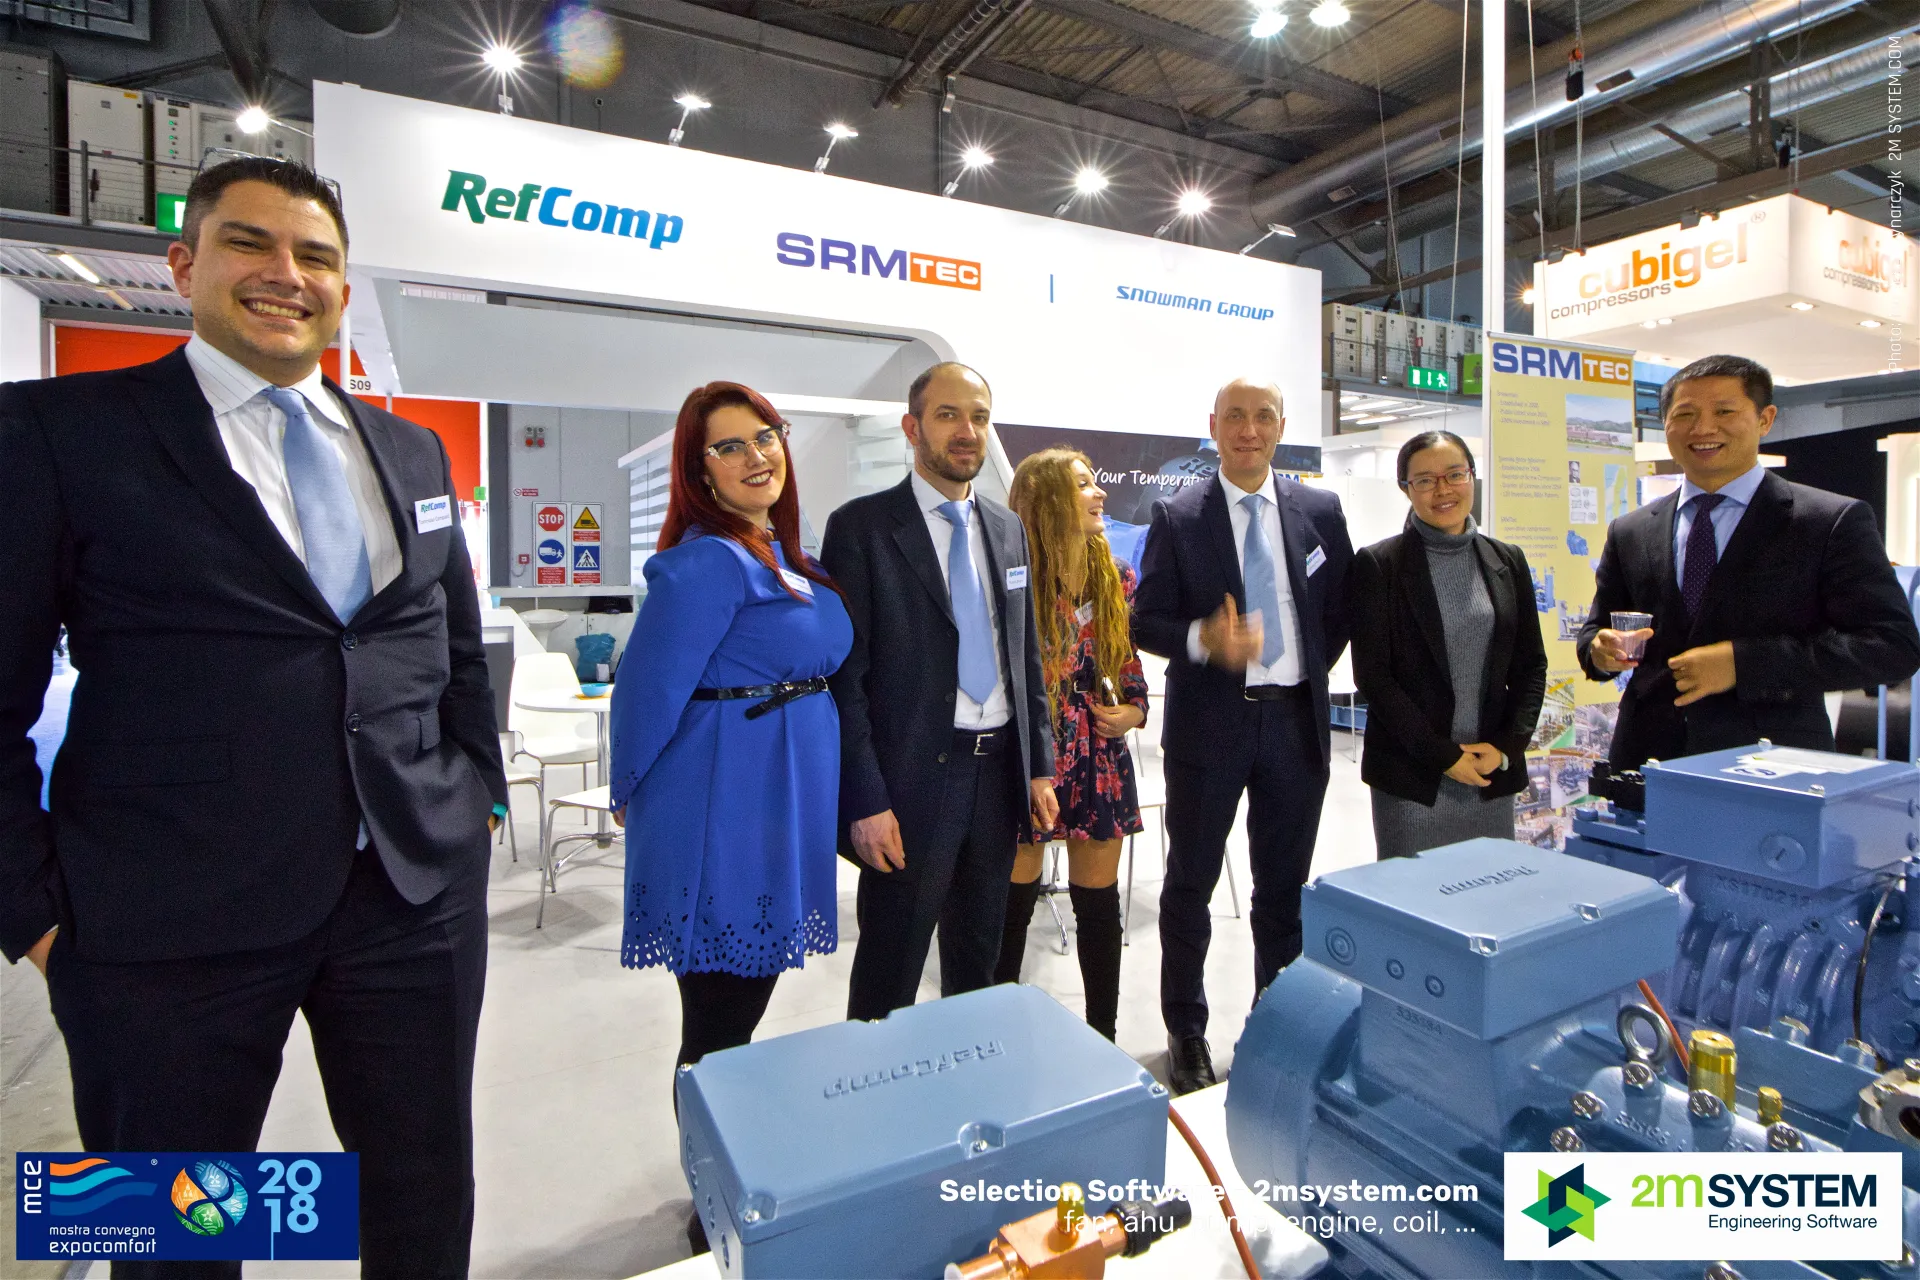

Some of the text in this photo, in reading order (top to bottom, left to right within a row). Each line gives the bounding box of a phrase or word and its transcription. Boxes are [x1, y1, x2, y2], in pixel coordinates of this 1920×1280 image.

[441, 169, 684, 250] RefComp
[1579, 222, 1748, 298] cubigel
[1823, 266, 1880, 293] compressors
[1116, 285, 1274, 321] SNOWMAN GROUP
[1550, 282, 1671, 319] compressors
[1090, 467, 1126, 484] Your
[421, 502, 446, 513] RefComp
[539, 514, 564, 524] STOP
